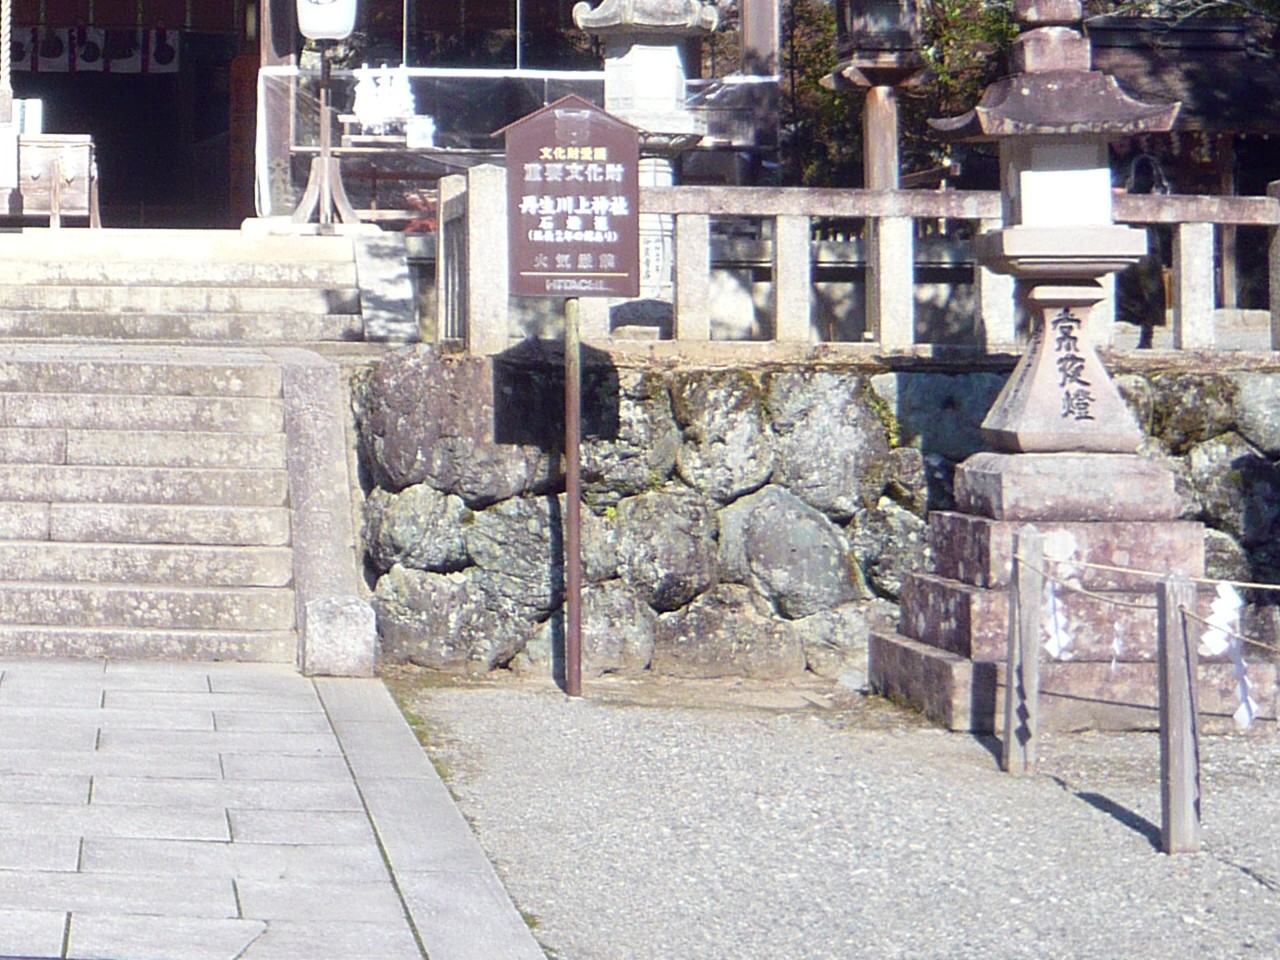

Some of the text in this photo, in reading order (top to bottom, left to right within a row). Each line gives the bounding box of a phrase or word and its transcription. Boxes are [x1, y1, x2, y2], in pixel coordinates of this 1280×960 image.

[523, 162, 624, 182] 重要文化財
[518, 195, 629, 216] 丹生川上神社
